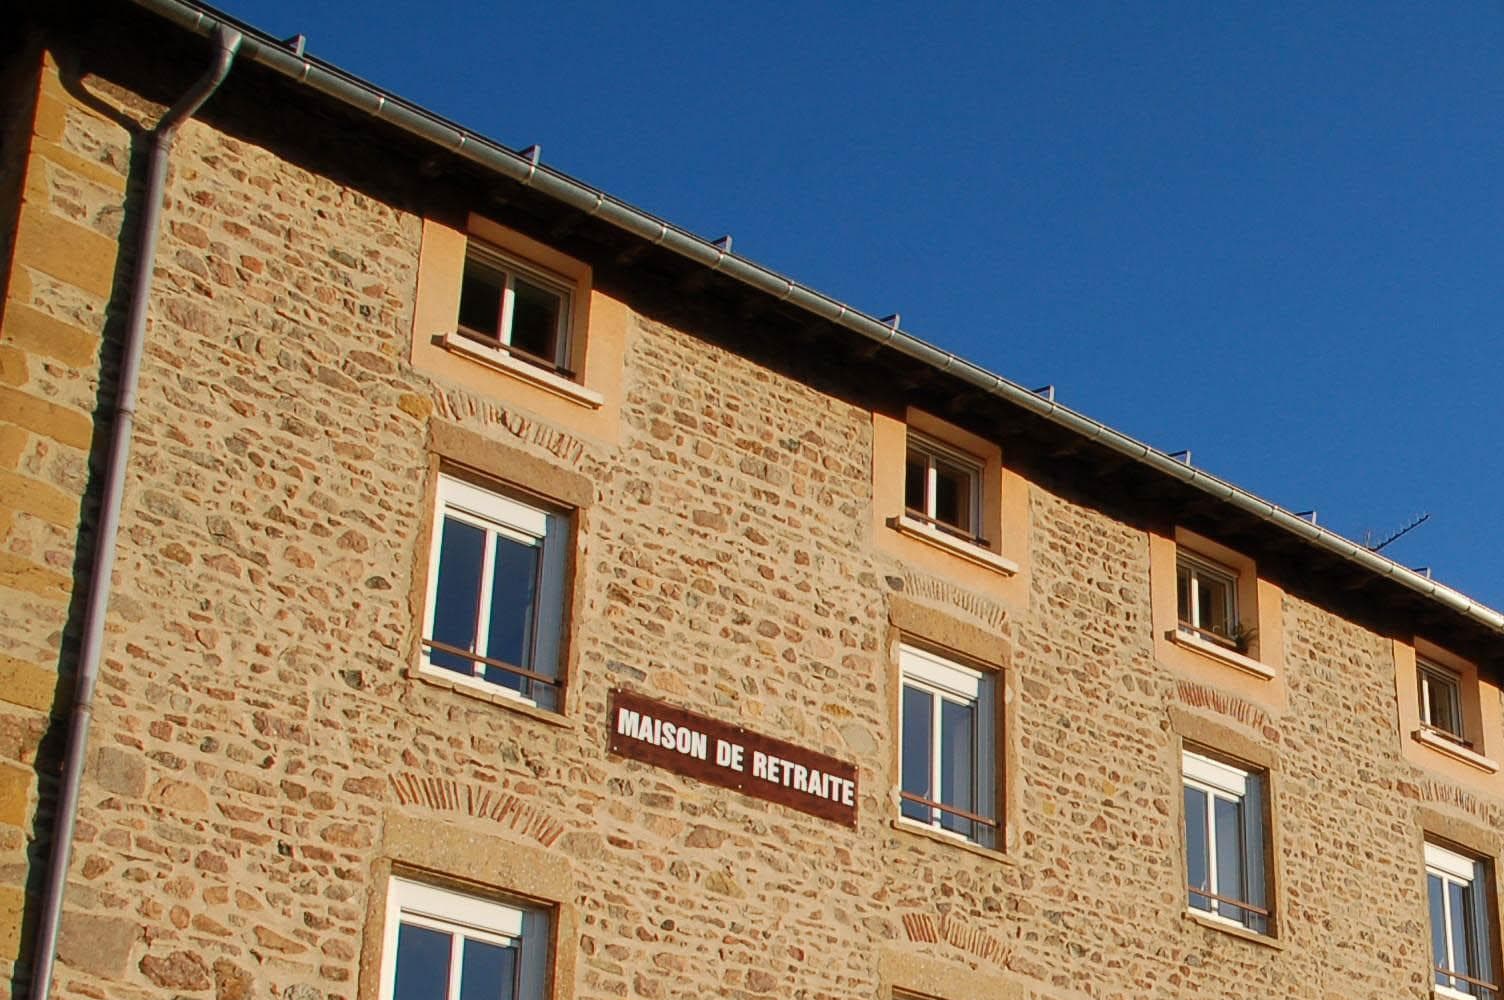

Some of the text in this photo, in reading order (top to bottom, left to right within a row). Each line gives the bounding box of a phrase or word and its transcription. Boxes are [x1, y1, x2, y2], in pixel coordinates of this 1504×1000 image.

[617, 708, 855, 806] MAISON DE RETRAITE
